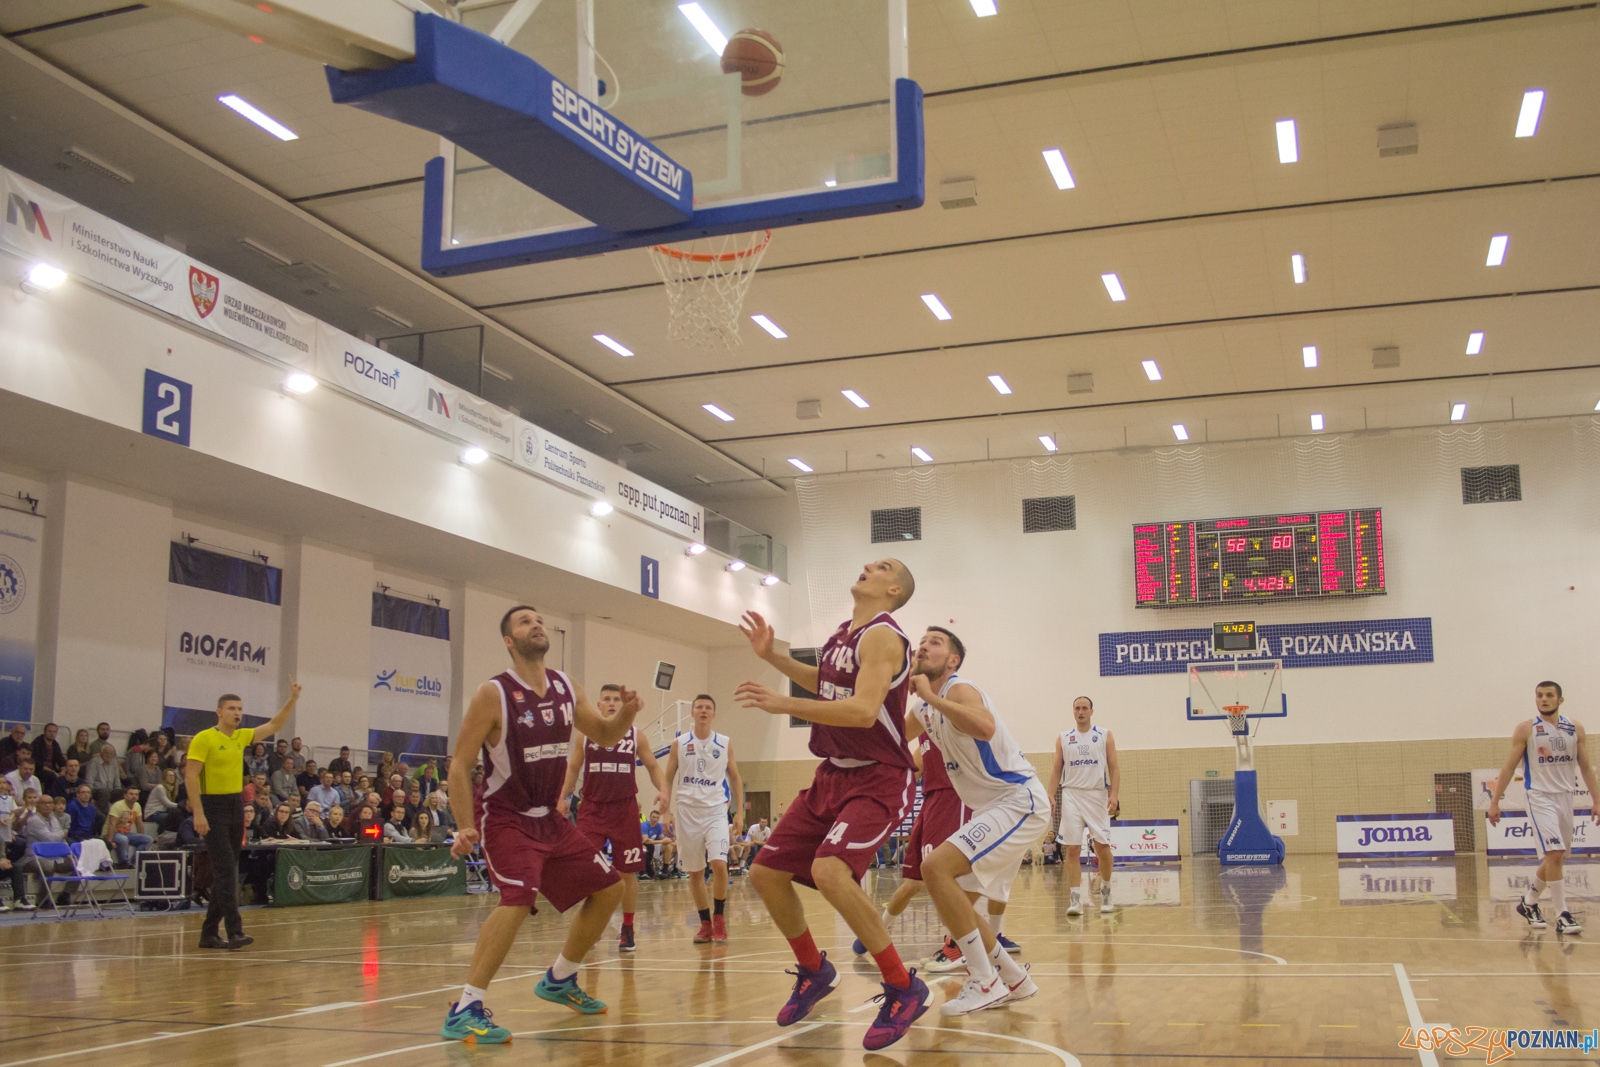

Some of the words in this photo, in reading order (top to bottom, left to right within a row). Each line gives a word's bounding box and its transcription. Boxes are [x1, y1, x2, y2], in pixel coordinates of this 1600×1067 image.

[551, 79, 616, 147] SPORT
[615, 128, 683, 192] SYSTEM
[72, 222, 131, 257] Ministerstwo
[132, 250, 159, 270] Nauki
[71, 238, 75, 247] i
[76, 240, 131, 272] Szkolnictwa
[132, 264, 174, 291] Wyższego
[243, 303, 287, 331] MARSZAŁKOWSKI
[156, 382, 181, 436] 2
[458, 402, 489, 423] Ministerstwo
[544, 439, 568, 460] Centrum
[568, 450, 587, 469] Sportu
[544, 456, 576, 481] Politechniki
[618, 481, 701, 534] cspp.put.poznan.pl
[1226, 538, 1247, 553] 52
[1272, 534, 1292, 550] 60
[647, 562, 654, 594] 1
[179, 631, 266, 667] BIOFARM
[1115, 636, 1273, 664] POLITECHA
[1280, 629, 1416, 657] POZNAŃSKA
[394, 686, 415, 694] biuro
[395, 671, 443, 693] funclub
[616, 738, 635, 755] 22
[1077, 744, 1090, 756] 12
[1548, 736, 1567, 752] 10
[696, 758, 707, 773] 0
[1538, 755, 1574, 764] BIOFAR
[967, 822, 992, 843] 6
[623, 847, 642, 865] 22
[1129, 842, 1169, 850] CYMES
